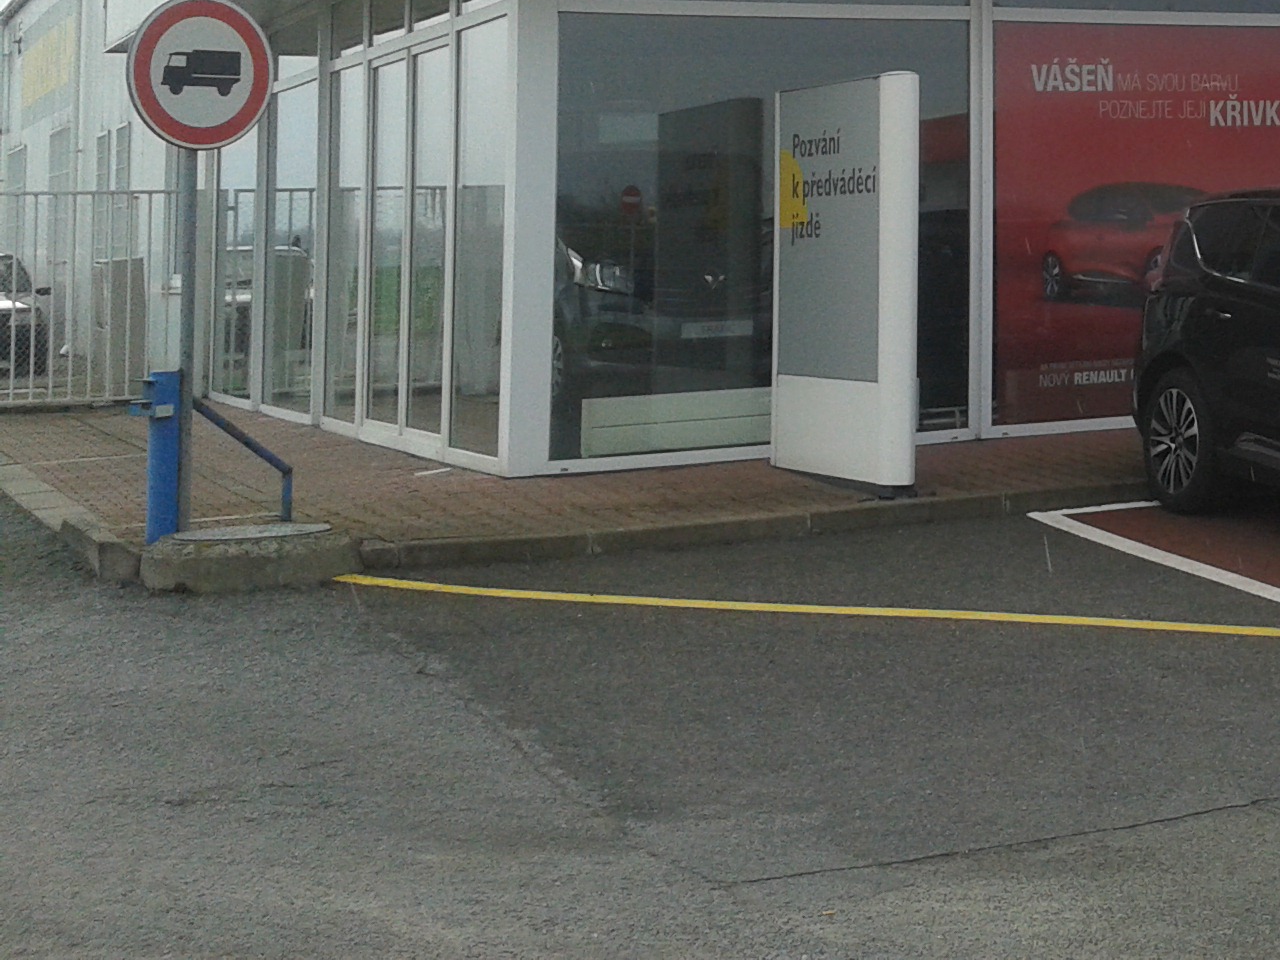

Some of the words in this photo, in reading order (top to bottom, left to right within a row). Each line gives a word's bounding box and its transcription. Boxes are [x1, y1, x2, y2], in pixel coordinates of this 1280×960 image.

[1030, 57, 1114, 92] VÁŠEŇ
[1146, 73, 1186, 92] SVOU
[1100, 99, 1173, 119] POZNEJTE
[792, 127, 841, 159] Pozvání
[791, 173, 800, 199] k
[802, 166, 877, 206] předváděcí
[791, 212, 822, 246] jízdě
[1073, 368, 1128, 385] RENAULT
